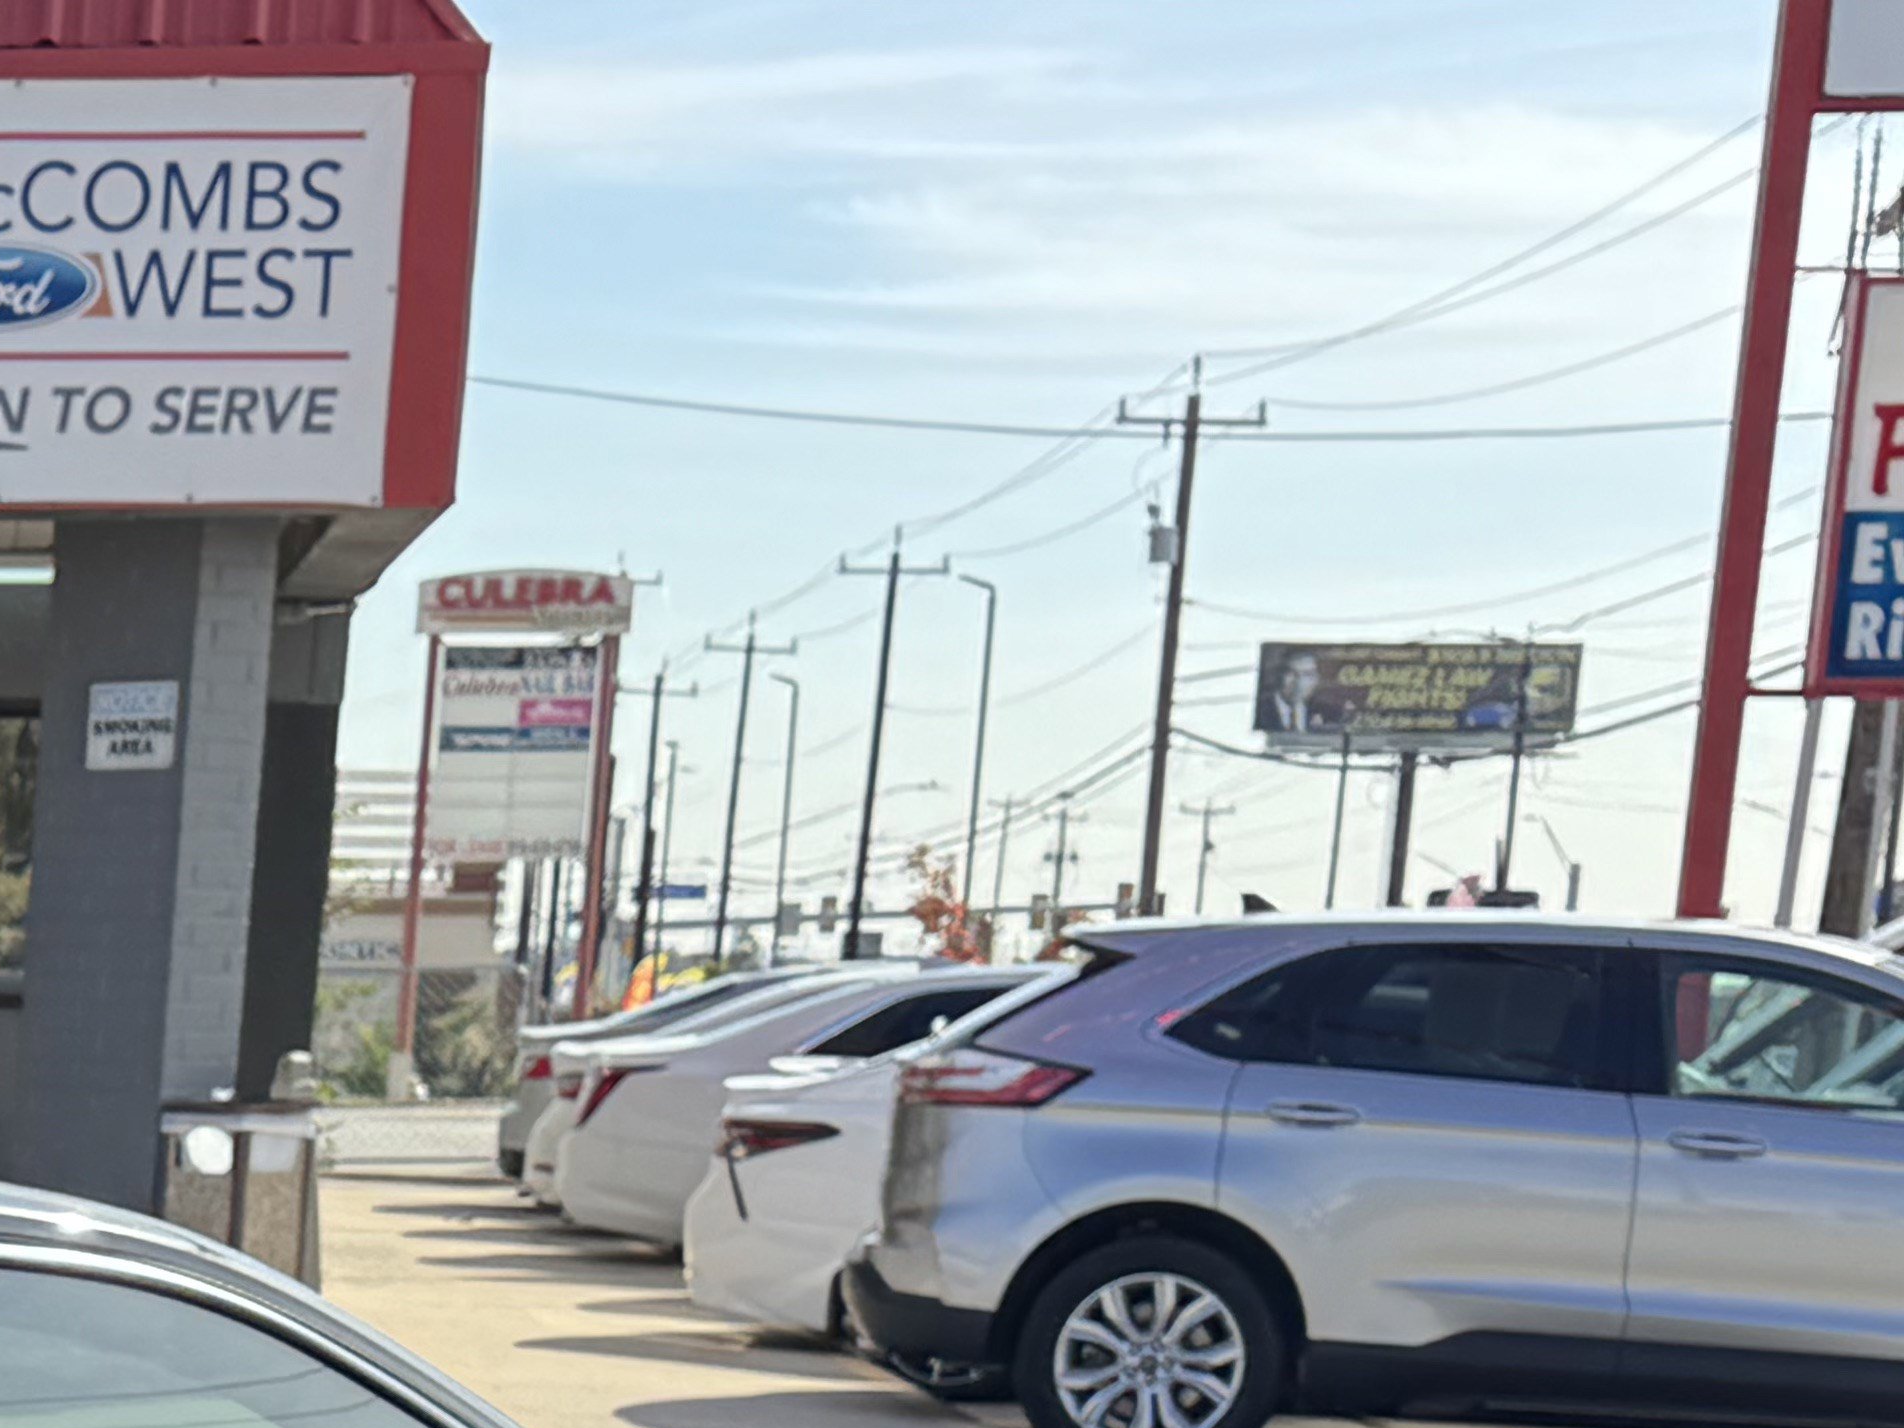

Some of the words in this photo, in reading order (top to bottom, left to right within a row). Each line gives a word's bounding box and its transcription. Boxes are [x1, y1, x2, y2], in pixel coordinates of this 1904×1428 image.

[113, 248, 353, 319] WEST
[53, 385, 133, 435] TO
[148, 385, 339, 435] SERVE
[438, 576, 616, 609] CULEBRA
[93, 718, 172, 736] SMOKING
[107, 738, 153, 756] AREA
